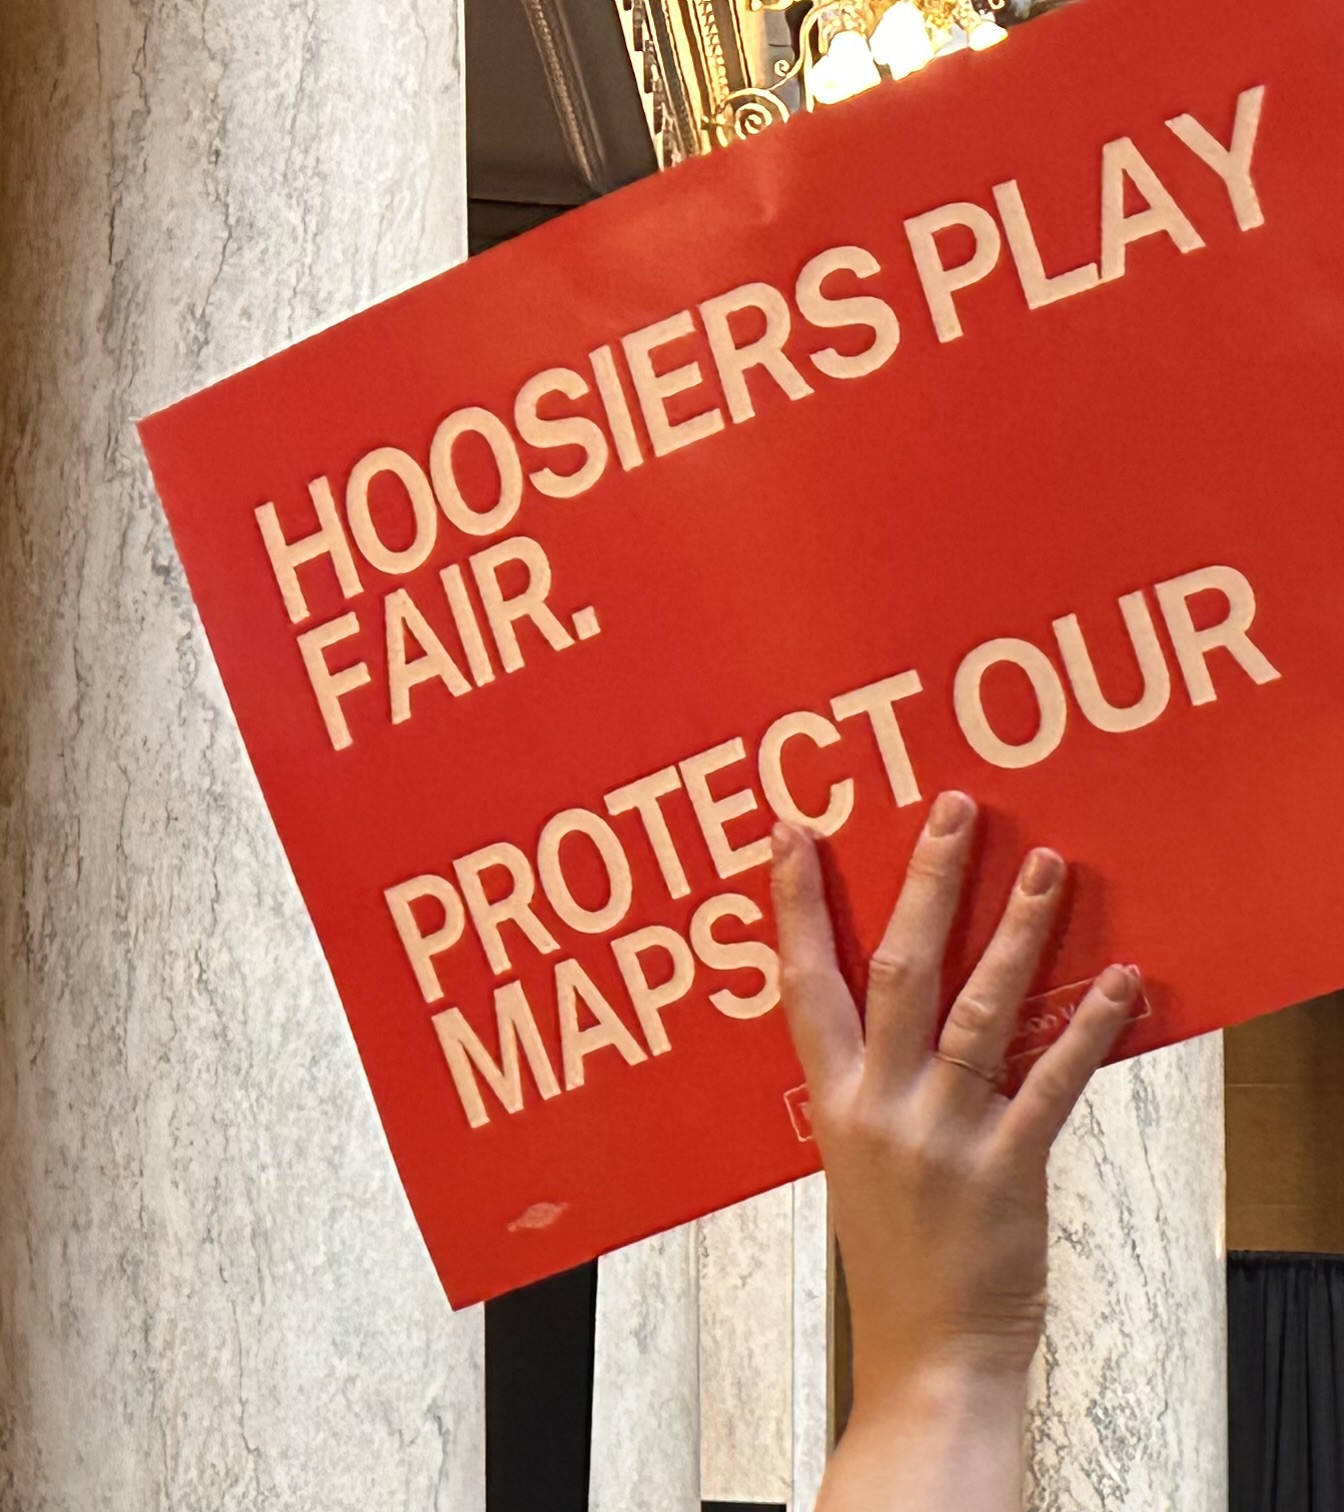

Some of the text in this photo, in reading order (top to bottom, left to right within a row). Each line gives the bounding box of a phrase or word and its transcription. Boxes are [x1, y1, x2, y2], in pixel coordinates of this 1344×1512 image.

[255, 86, 1265, 624] HOOSIERS PLAY
[297, 537, 601, 751] FAIR.
[384, 566, 1281, 1003] PROTECT OUR
[432, 893, 781, 1128] MAPS
